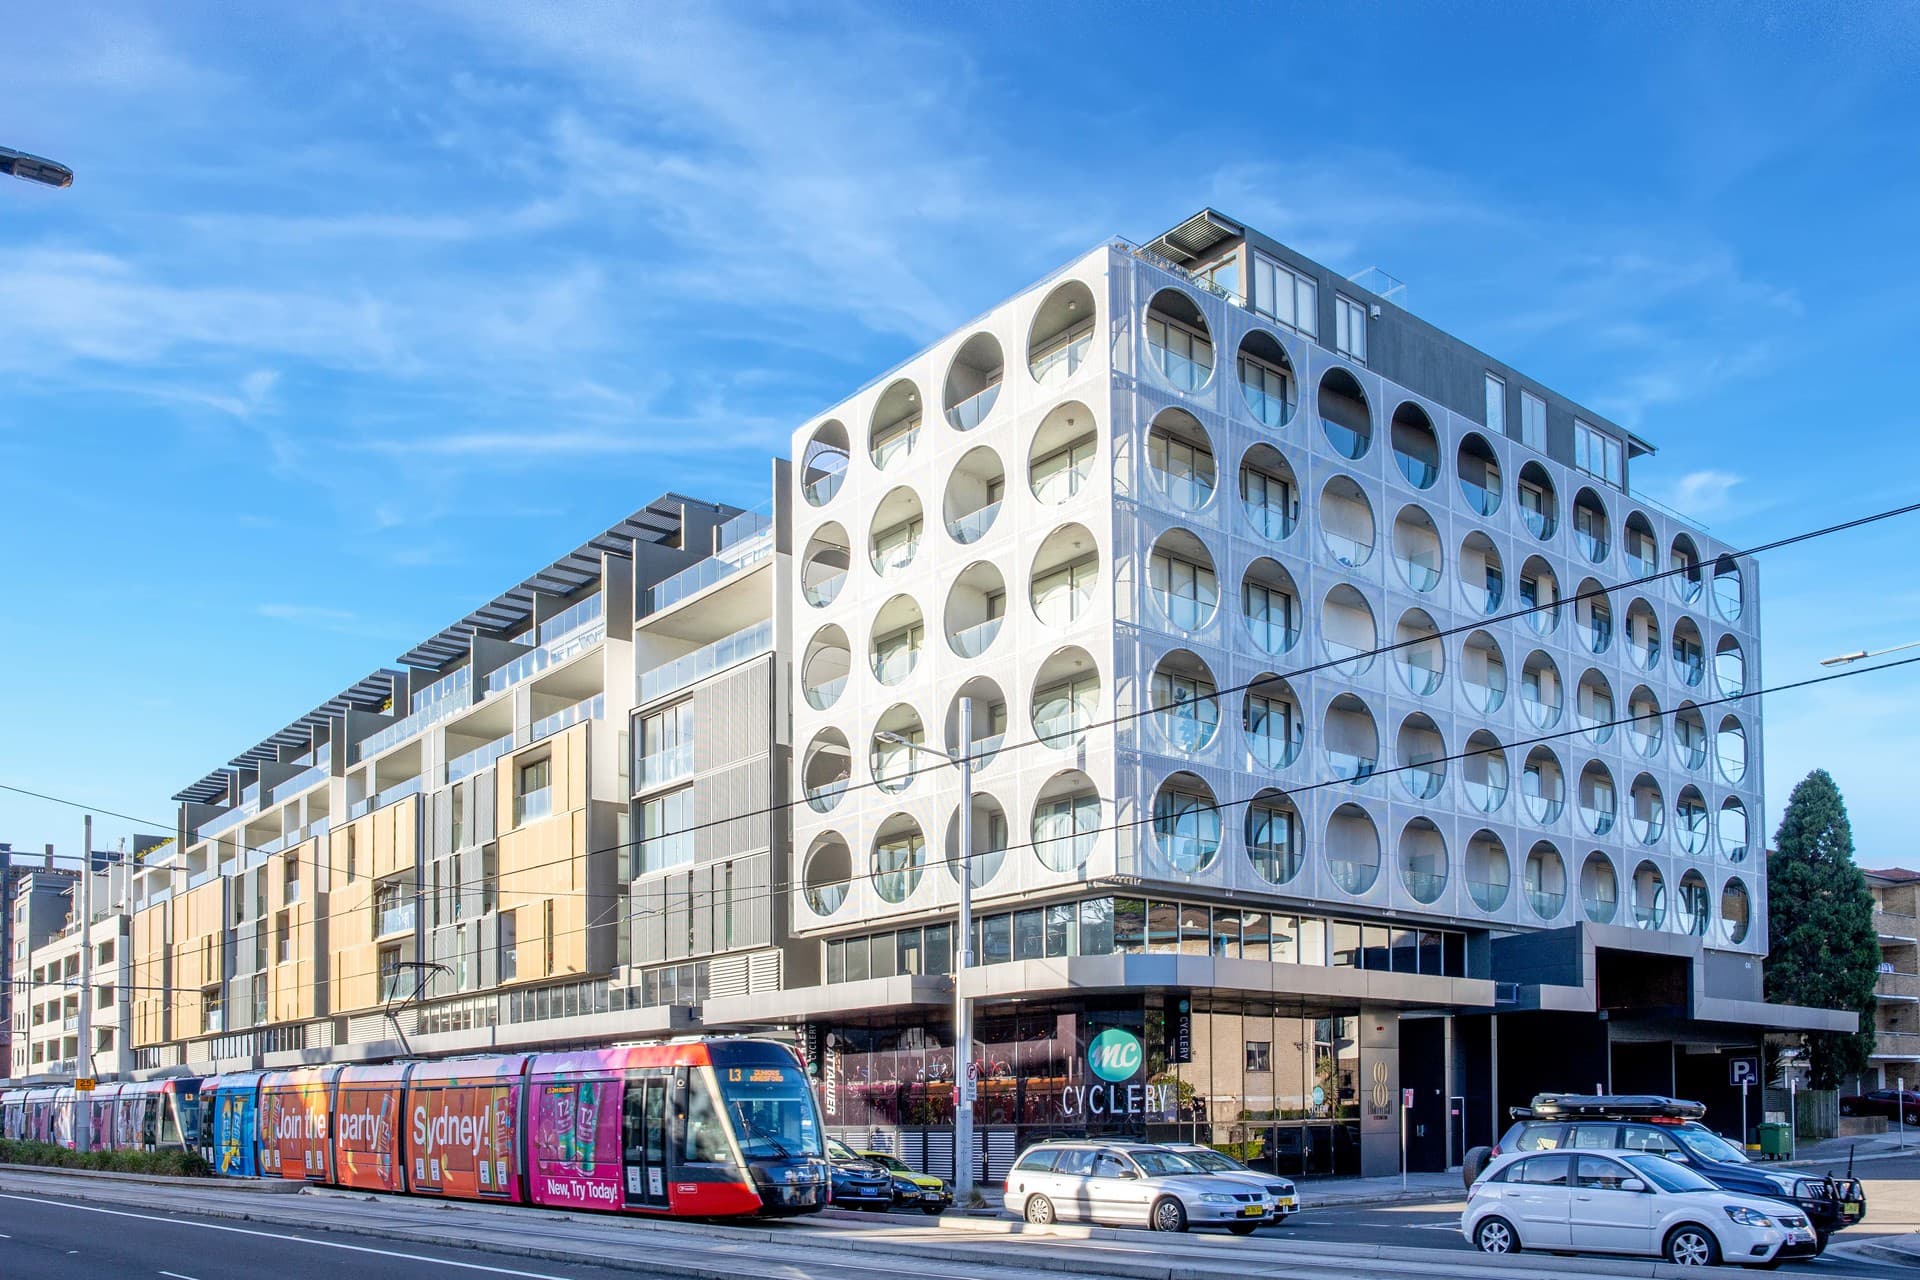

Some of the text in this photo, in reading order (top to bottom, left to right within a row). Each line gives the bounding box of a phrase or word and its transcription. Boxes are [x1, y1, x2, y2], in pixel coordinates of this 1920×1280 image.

[808, 1025, 816, 1061] CYCLERY
[1180, 1017, 1189, 1059] CYCLERY
[729, 1069, 742, 1082] L3
[827, 1047, 835, 1115] ATTAQUER
[1734, 1061, 1750, 1082] P
[558, 1099, 569, 1117] T2
[1063, 1084, 1168, 1114] CYCLERY
[581, 1107, 593, 1125] T2
[276, 1108, 301, 1139] Join
[304, 1110, 326, 1139] the
[339, 1108, 381, 1150] party
[413, 1105, 490, 1156] Sydney!
[547, 1179, 618, 1203] New, Try Today!
